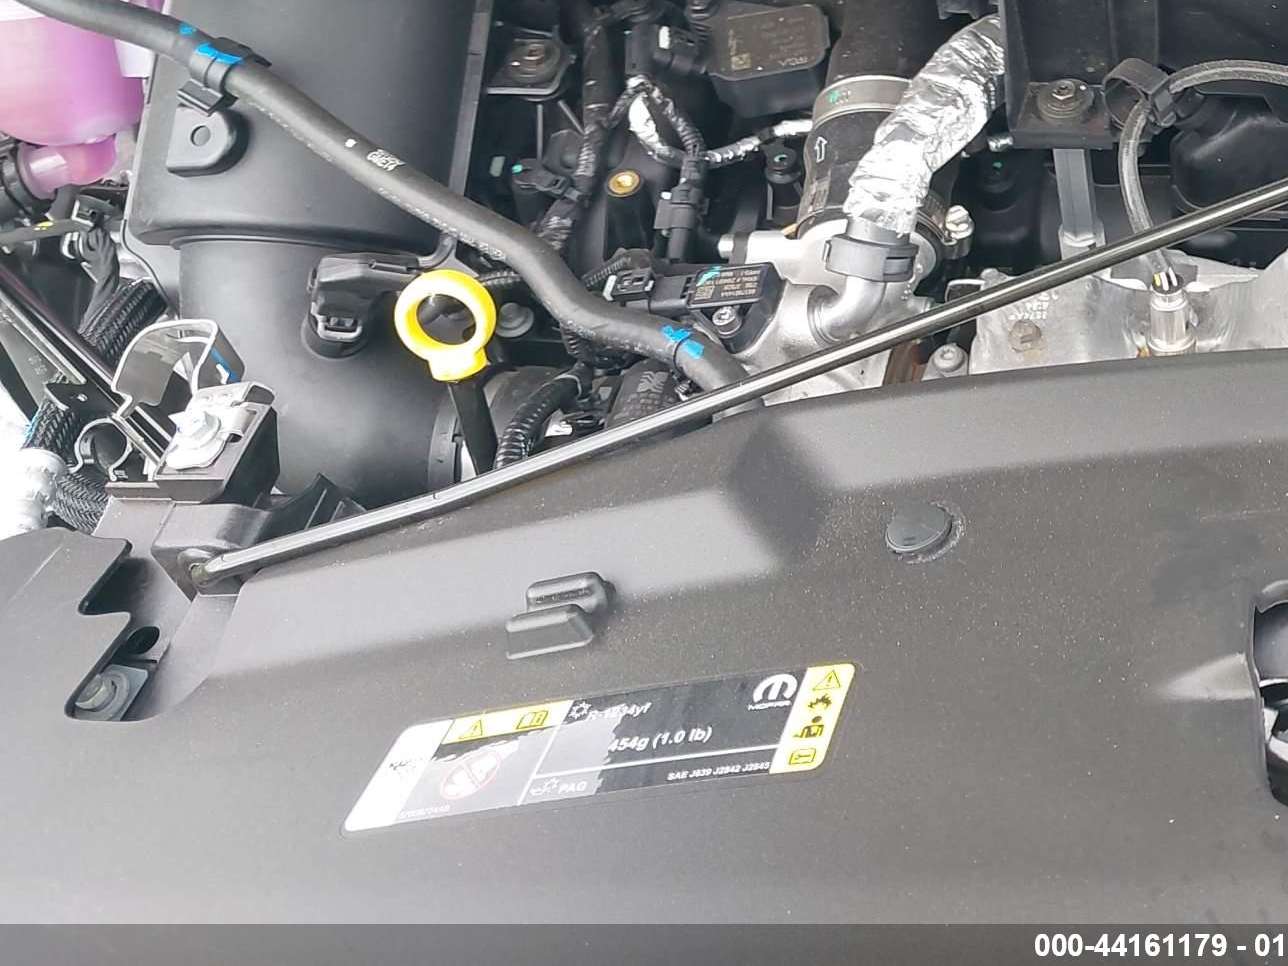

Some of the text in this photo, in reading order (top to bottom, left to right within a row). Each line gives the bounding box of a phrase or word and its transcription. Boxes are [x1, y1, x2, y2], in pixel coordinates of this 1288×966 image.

[608, 726, 713, 752] 454g (1.0 lb)
[666, 771, 689, 781] SAE
[558, 780, 589, 795] PAG
